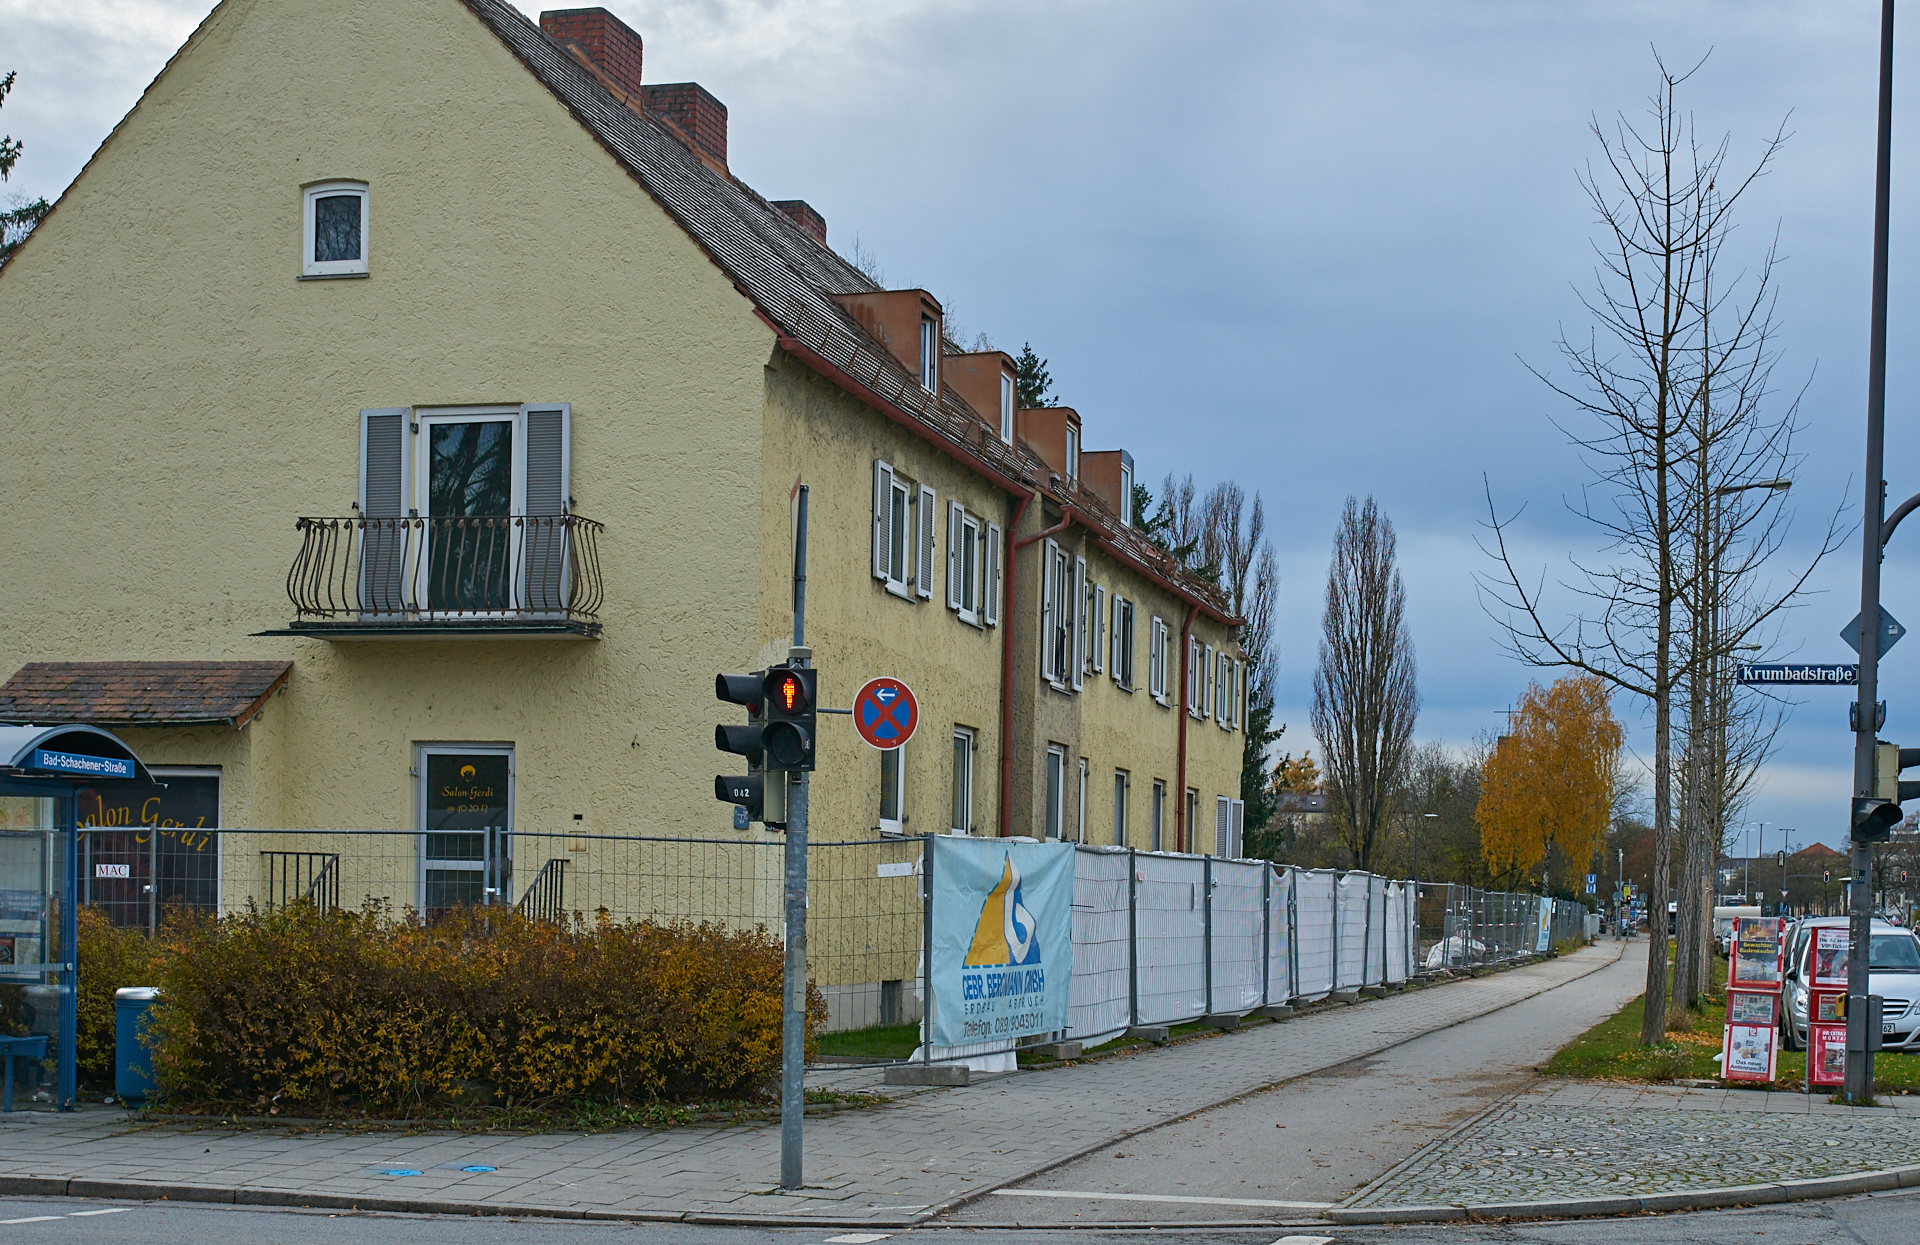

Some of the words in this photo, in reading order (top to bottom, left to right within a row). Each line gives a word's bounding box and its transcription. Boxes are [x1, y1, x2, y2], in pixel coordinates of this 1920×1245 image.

[1743, 666, 1853, 683] Krumbadstraße
[43, 752, 127, 774] Bad-Schachener-Straße
[442, 786, 467, 796] Salon
[469, 786, 493, 799] Gerdi
[734, 788, 750, 797] 042
[99, 865, 128, 876] MAC
[1587, 874, 1595, 883] U
